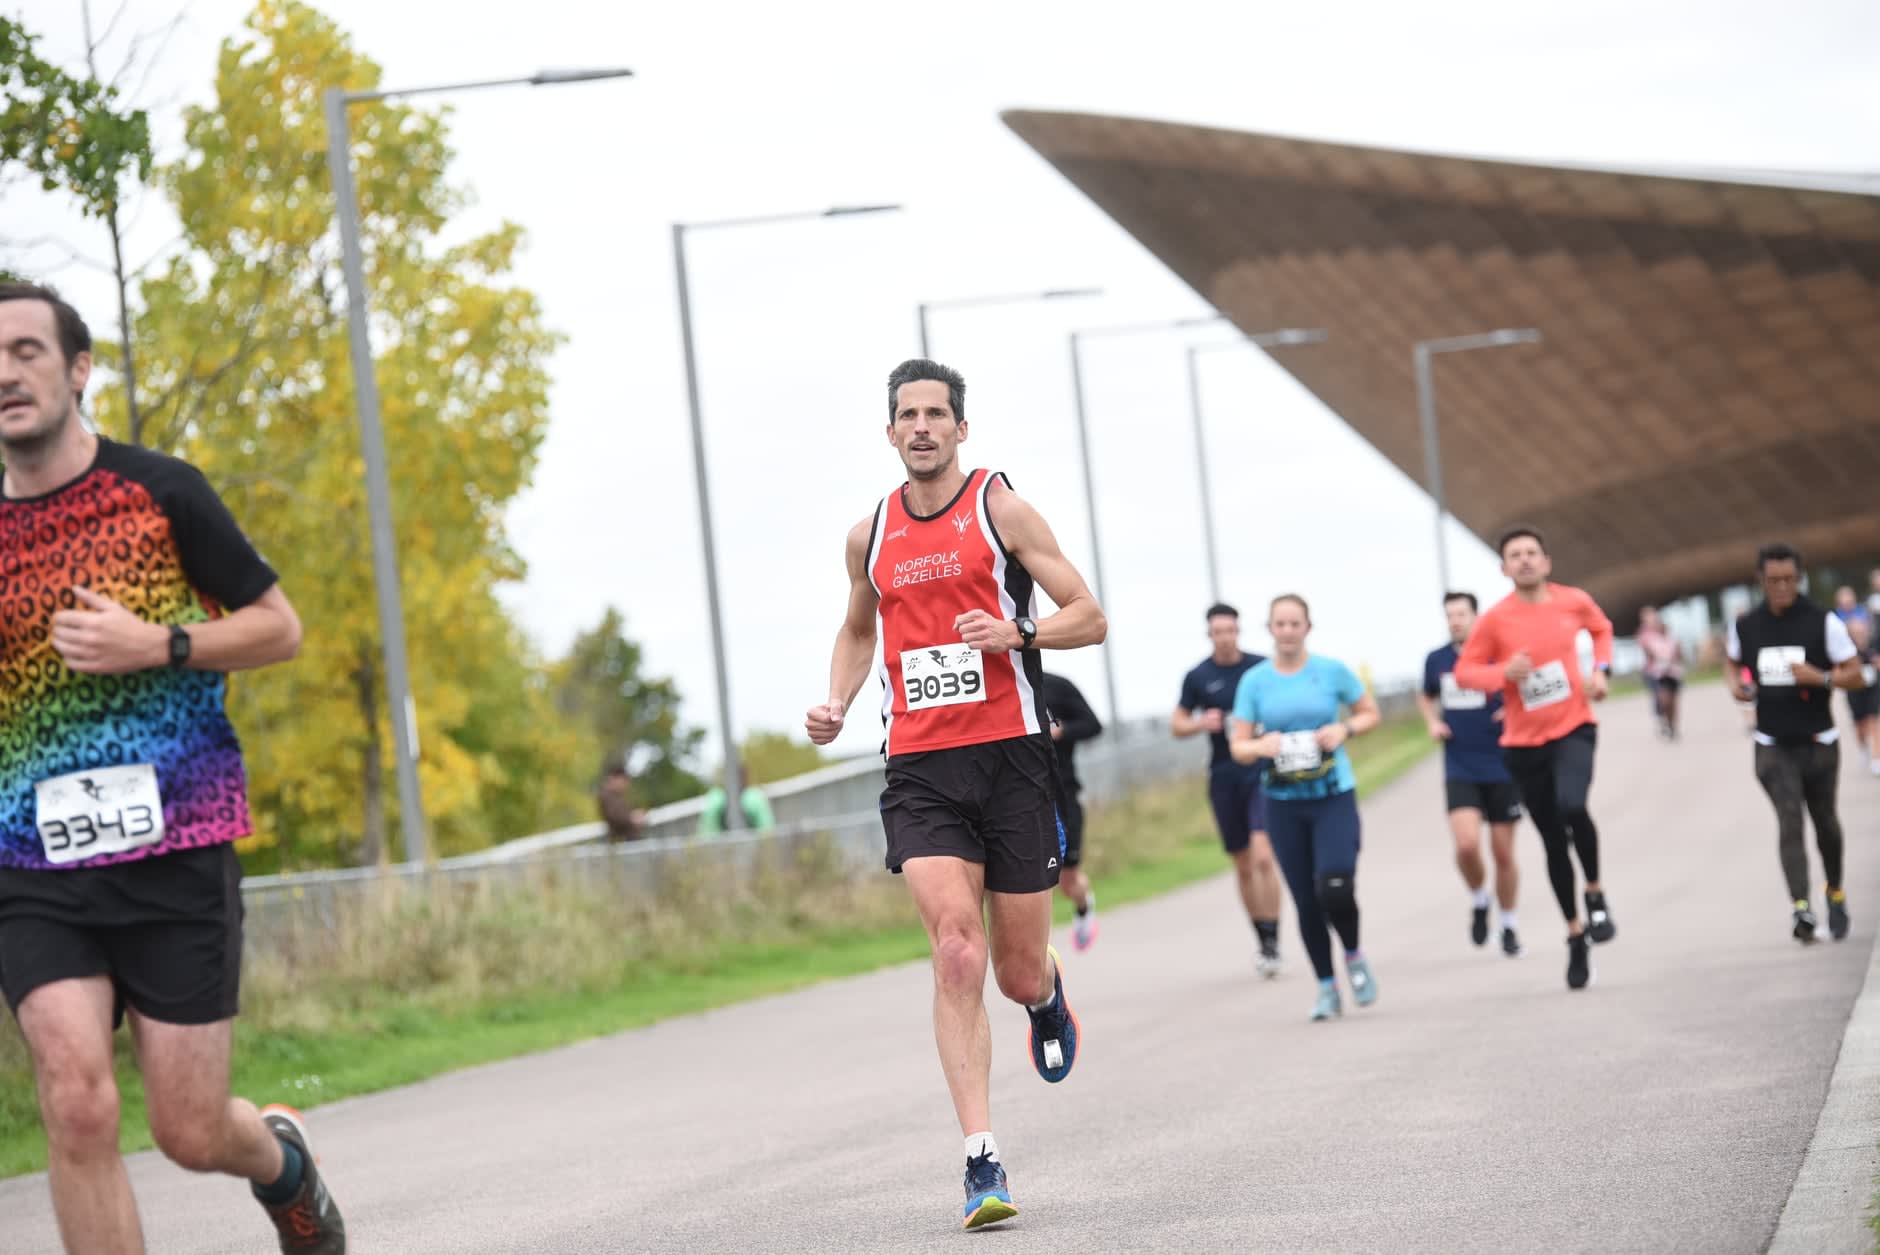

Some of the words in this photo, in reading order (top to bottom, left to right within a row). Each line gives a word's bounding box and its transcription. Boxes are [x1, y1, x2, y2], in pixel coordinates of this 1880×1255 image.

[893, 564, 962, 588] GAZELLES
[894, 551, 960, 574] NORFOLK
[906, 670, 981, 703] 3039
[42, 805, 154, 851] 3343
